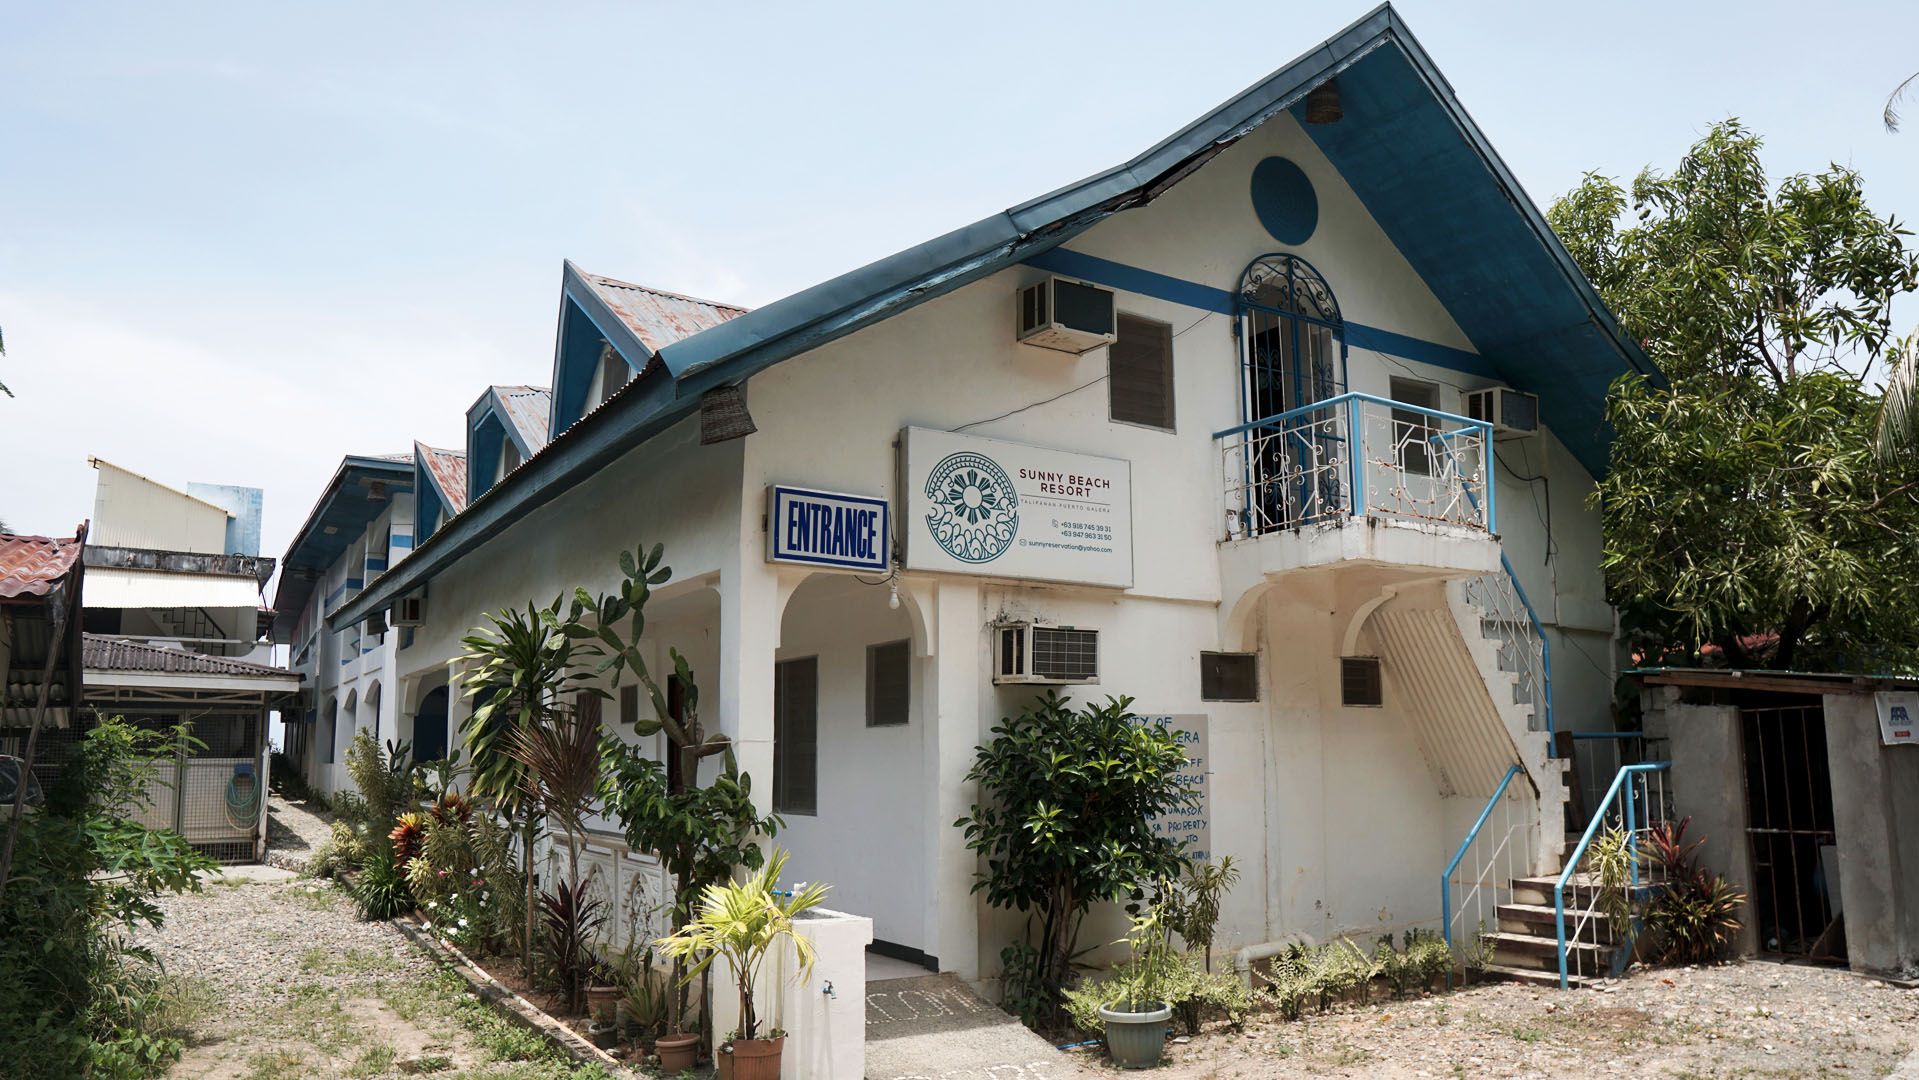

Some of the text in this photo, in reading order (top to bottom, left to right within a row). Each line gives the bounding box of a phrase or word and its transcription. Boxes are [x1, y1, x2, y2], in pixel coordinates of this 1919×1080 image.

[1019, 468, 1111, 489] SUNNY BEACH
[1040, 482, 1092, 498] RESORT
[1059, 503, 1084, 511] PUERTO
[787, 500, 878, 559] ENTRANCE
[1060, 521, 1072, 529] +63
[1028, 540, 1113, 553] sunnyreservation@yahoo.com
[1156, 717, 1172, 728] OF
[1175, 774, 1204, 785] BEACH
[1152, 819, 1207, 833] SA PROPERTY
